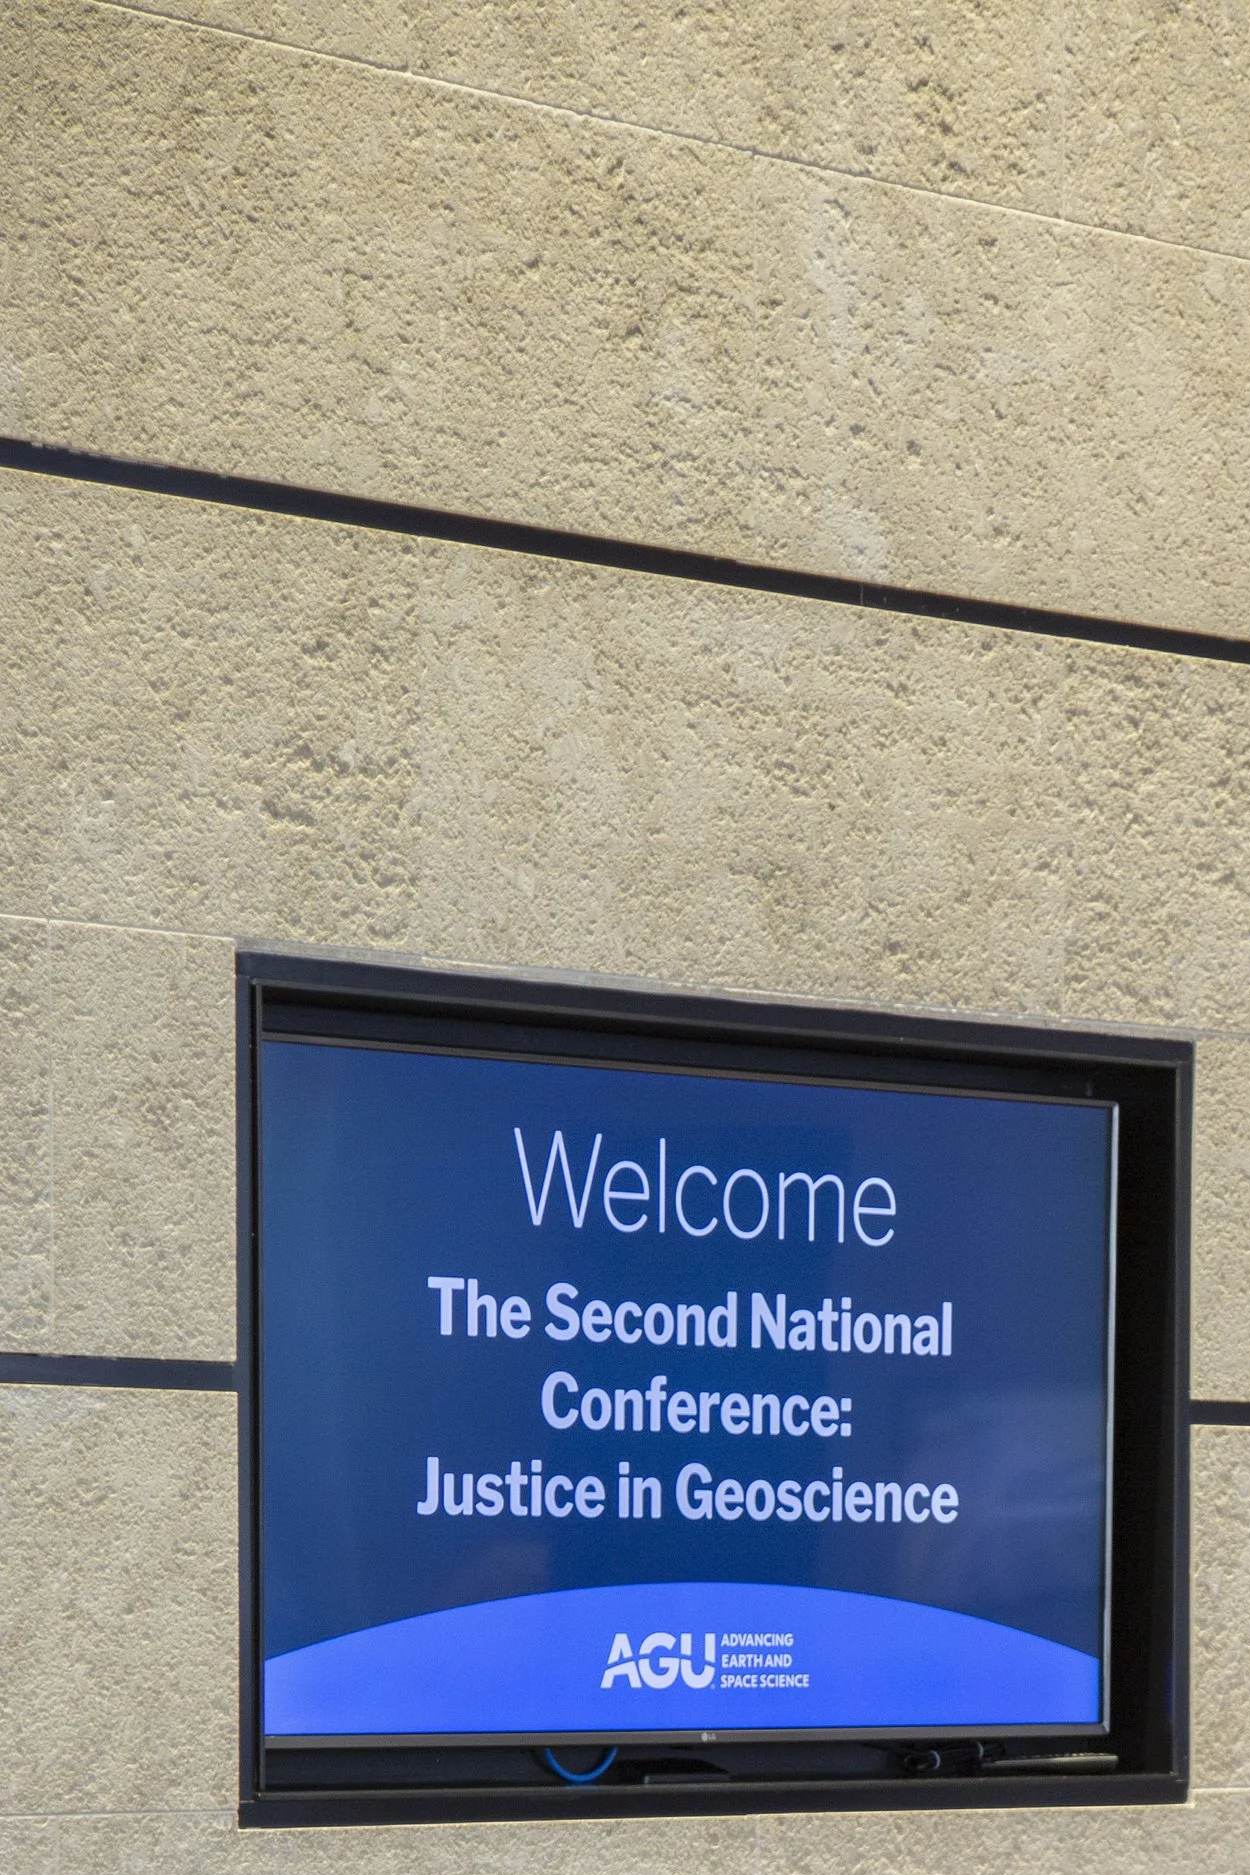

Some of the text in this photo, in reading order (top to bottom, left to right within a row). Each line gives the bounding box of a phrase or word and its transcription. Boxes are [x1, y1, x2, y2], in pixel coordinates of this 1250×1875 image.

[514, 1127, 897, 1246] Welcome
[427, 1276, 952, 1356] The Second National
[542, 1371, 852, 1437] Conference:
[417, 1456, 959, 1523] Justice in Geoscience
[601, 1632, 716, 1689] AGU
[720, 1633, 794, 1647] ADVANCING
[721, 1654, 792, 1668] EARTH AND
[720, 1674, 810, 1688] SPACE SCIENCE
